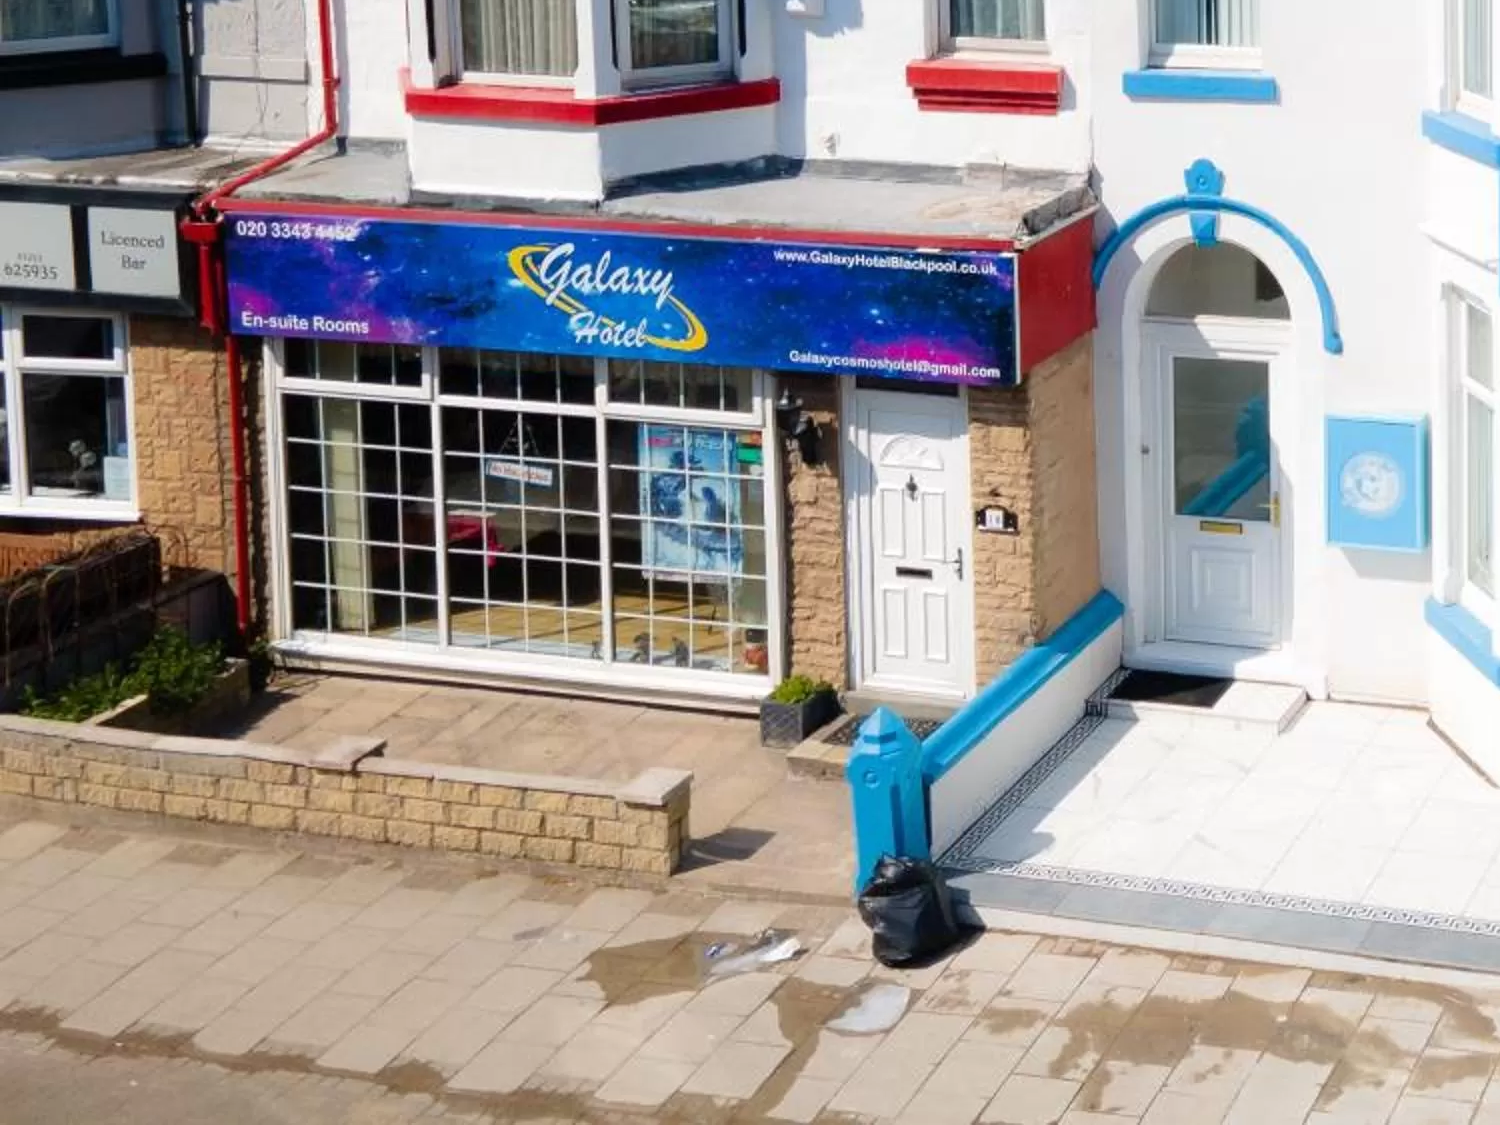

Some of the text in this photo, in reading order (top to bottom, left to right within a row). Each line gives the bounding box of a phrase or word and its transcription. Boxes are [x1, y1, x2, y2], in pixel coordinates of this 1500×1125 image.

[101, 231, 165, 249] Licenced
[235, 220, 267, 237] 020
[121, 255, 147, 271] Bar
[774, 248, 998, 275] www.GalaxyHotelBlackpool.co.uk
[540, 243, 673, 310] Galaxy
[241, 312, 369, 334] En-suite Rooms
[570, 311, 648, 348] Hotel
[789, 350, 1000, 378] Galaxycosmoshotel@gmail.com
